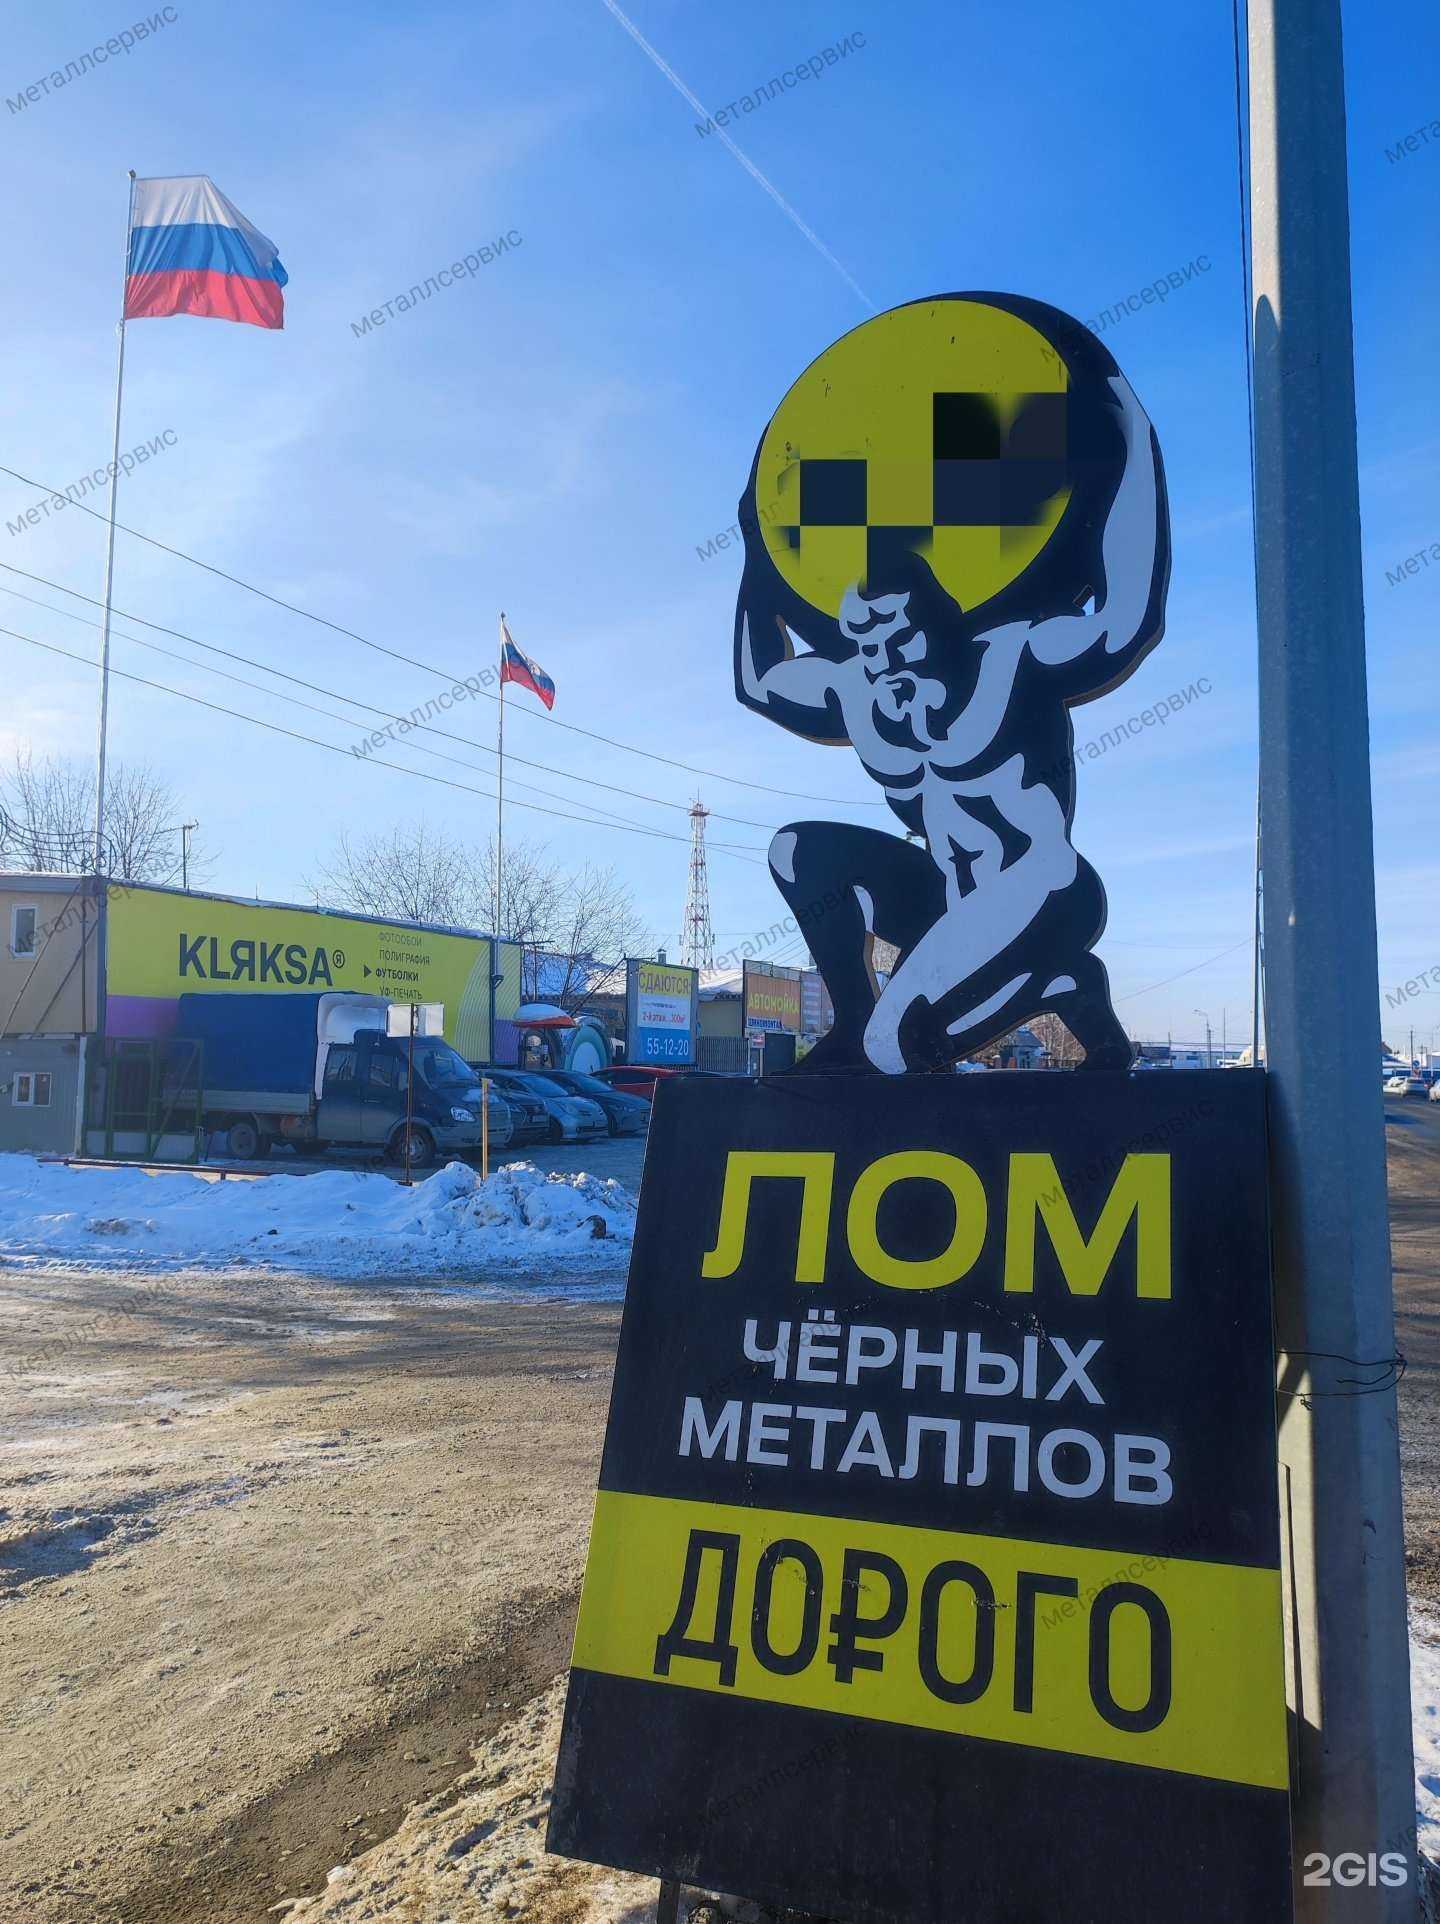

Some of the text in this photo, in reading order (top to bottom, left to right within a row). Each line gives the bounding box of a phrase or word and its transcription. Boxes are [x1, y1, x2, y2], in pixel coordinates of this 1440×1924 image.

[379, 949, 430, 966] ПОЛИГРАФИЯ
[375, 967, 419, 982] ФУТБОЛКИ
[379, 986, 424, 1000] УФ-ПЕЧАТЬ
[747, 991, 800, 1016] АВТОМОЙКА
[647, 1037, 689, 1056] 55-12-20
[702, 1150, 1171, 1299] ЛОМ
[743, 1309, 1106, 1404] ЧЁРНЫХ
[678, 1396, 1174, 1506] МЕТАЛЛОВ
